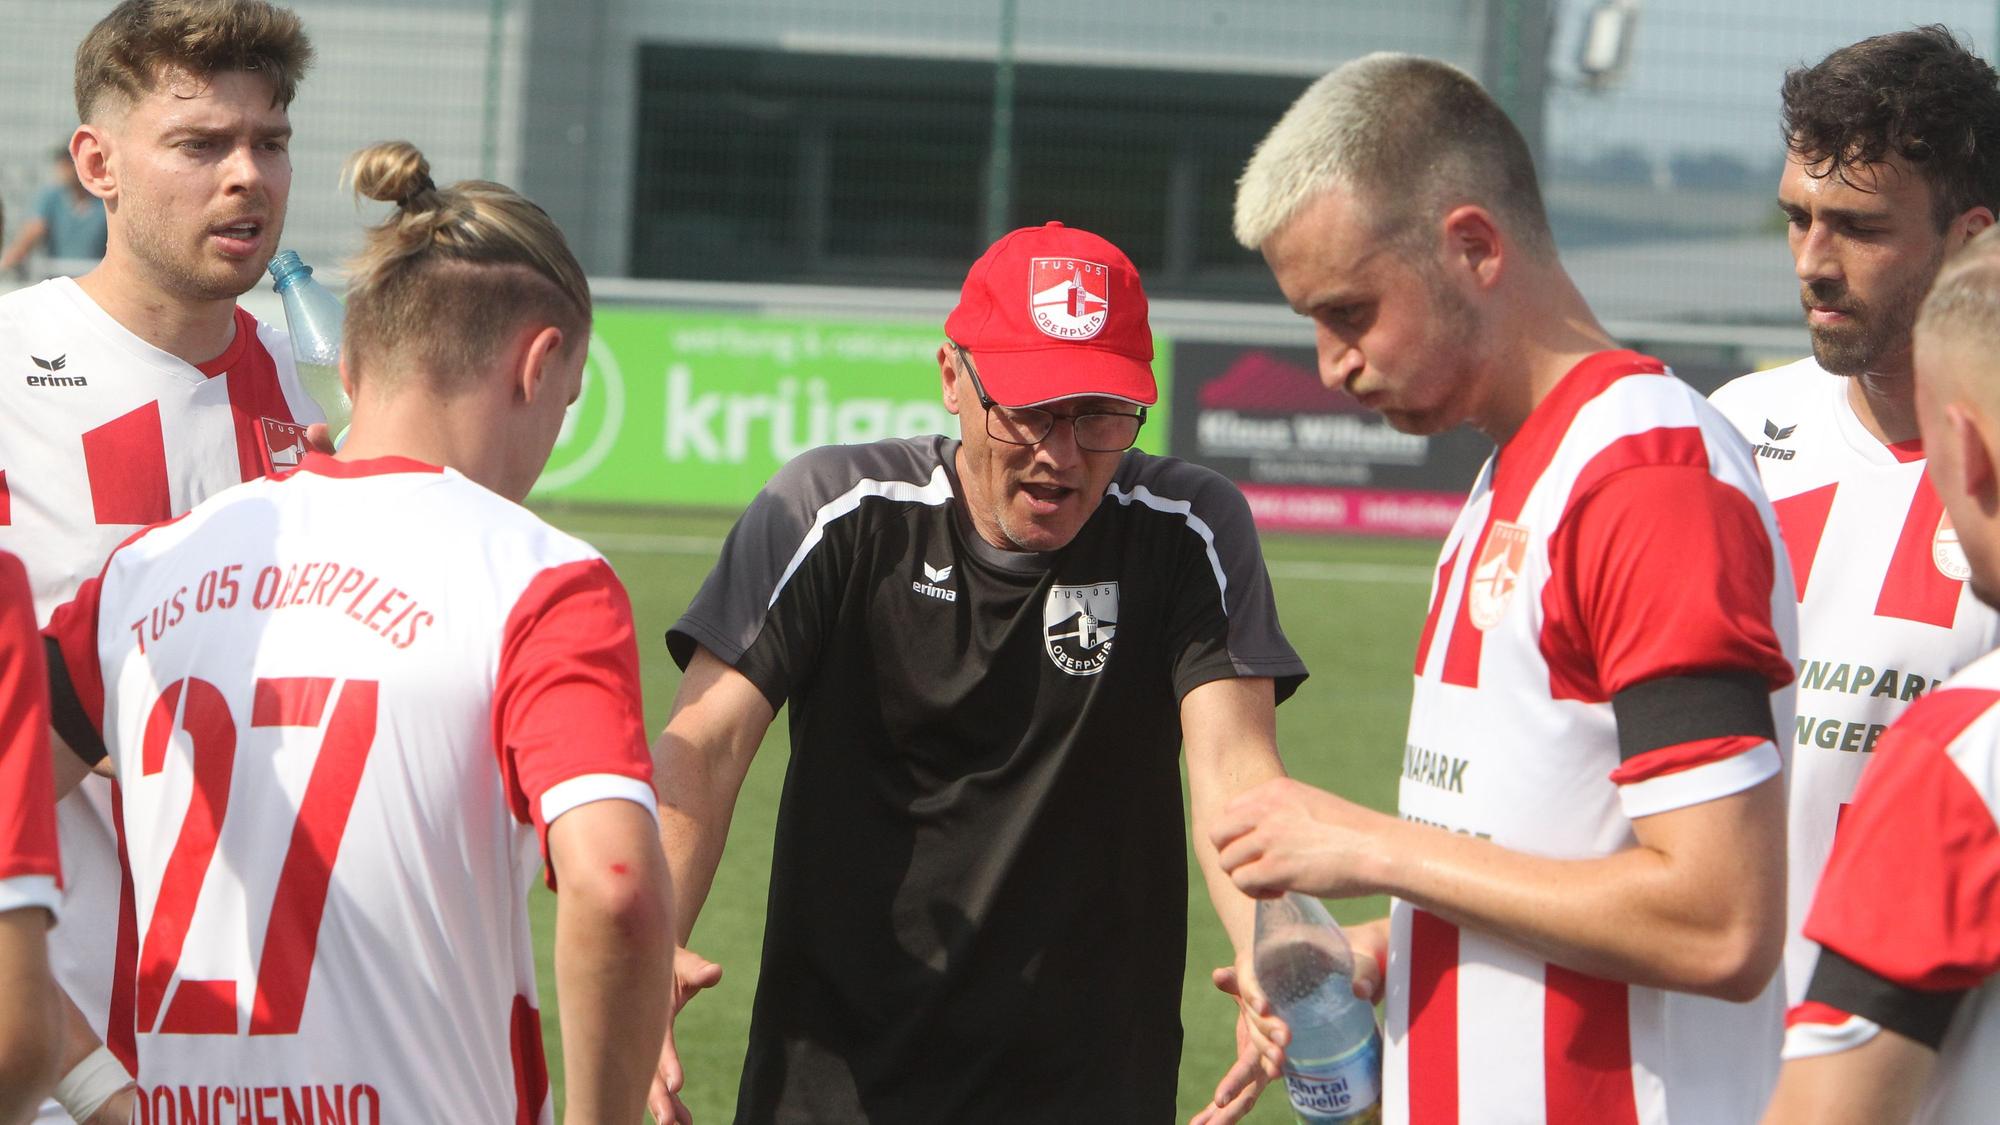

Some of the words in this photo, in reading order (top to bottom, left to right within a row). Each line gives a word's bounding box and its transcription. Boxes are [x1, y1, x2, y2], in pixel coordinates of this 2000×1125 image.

[1040, 260, 1075, 270] TUS
[1084, 263, 1102, 276] 05
[1038, 311, 1101, 337] OBERPLEIS
[26, 373, 88, 388] erima
[664, 363, 955, 464] krüge
[268, 422, 295, 435] TUS
[912, 580, 957, 602] erima
[1052, 589, 1083, 599] TUS
[1092, 587, 1111, 597] 05
[130, 585, 188, 656] TUS
[195, 563, 243, 613] 05
[251, 561, 435, 650] OBERPLEIS
[1053, 640, 1113, 670] OBERPLEIS
[1799, 658, 1942, 703] NAPAR
[136, 675, 380, 1037] 27
